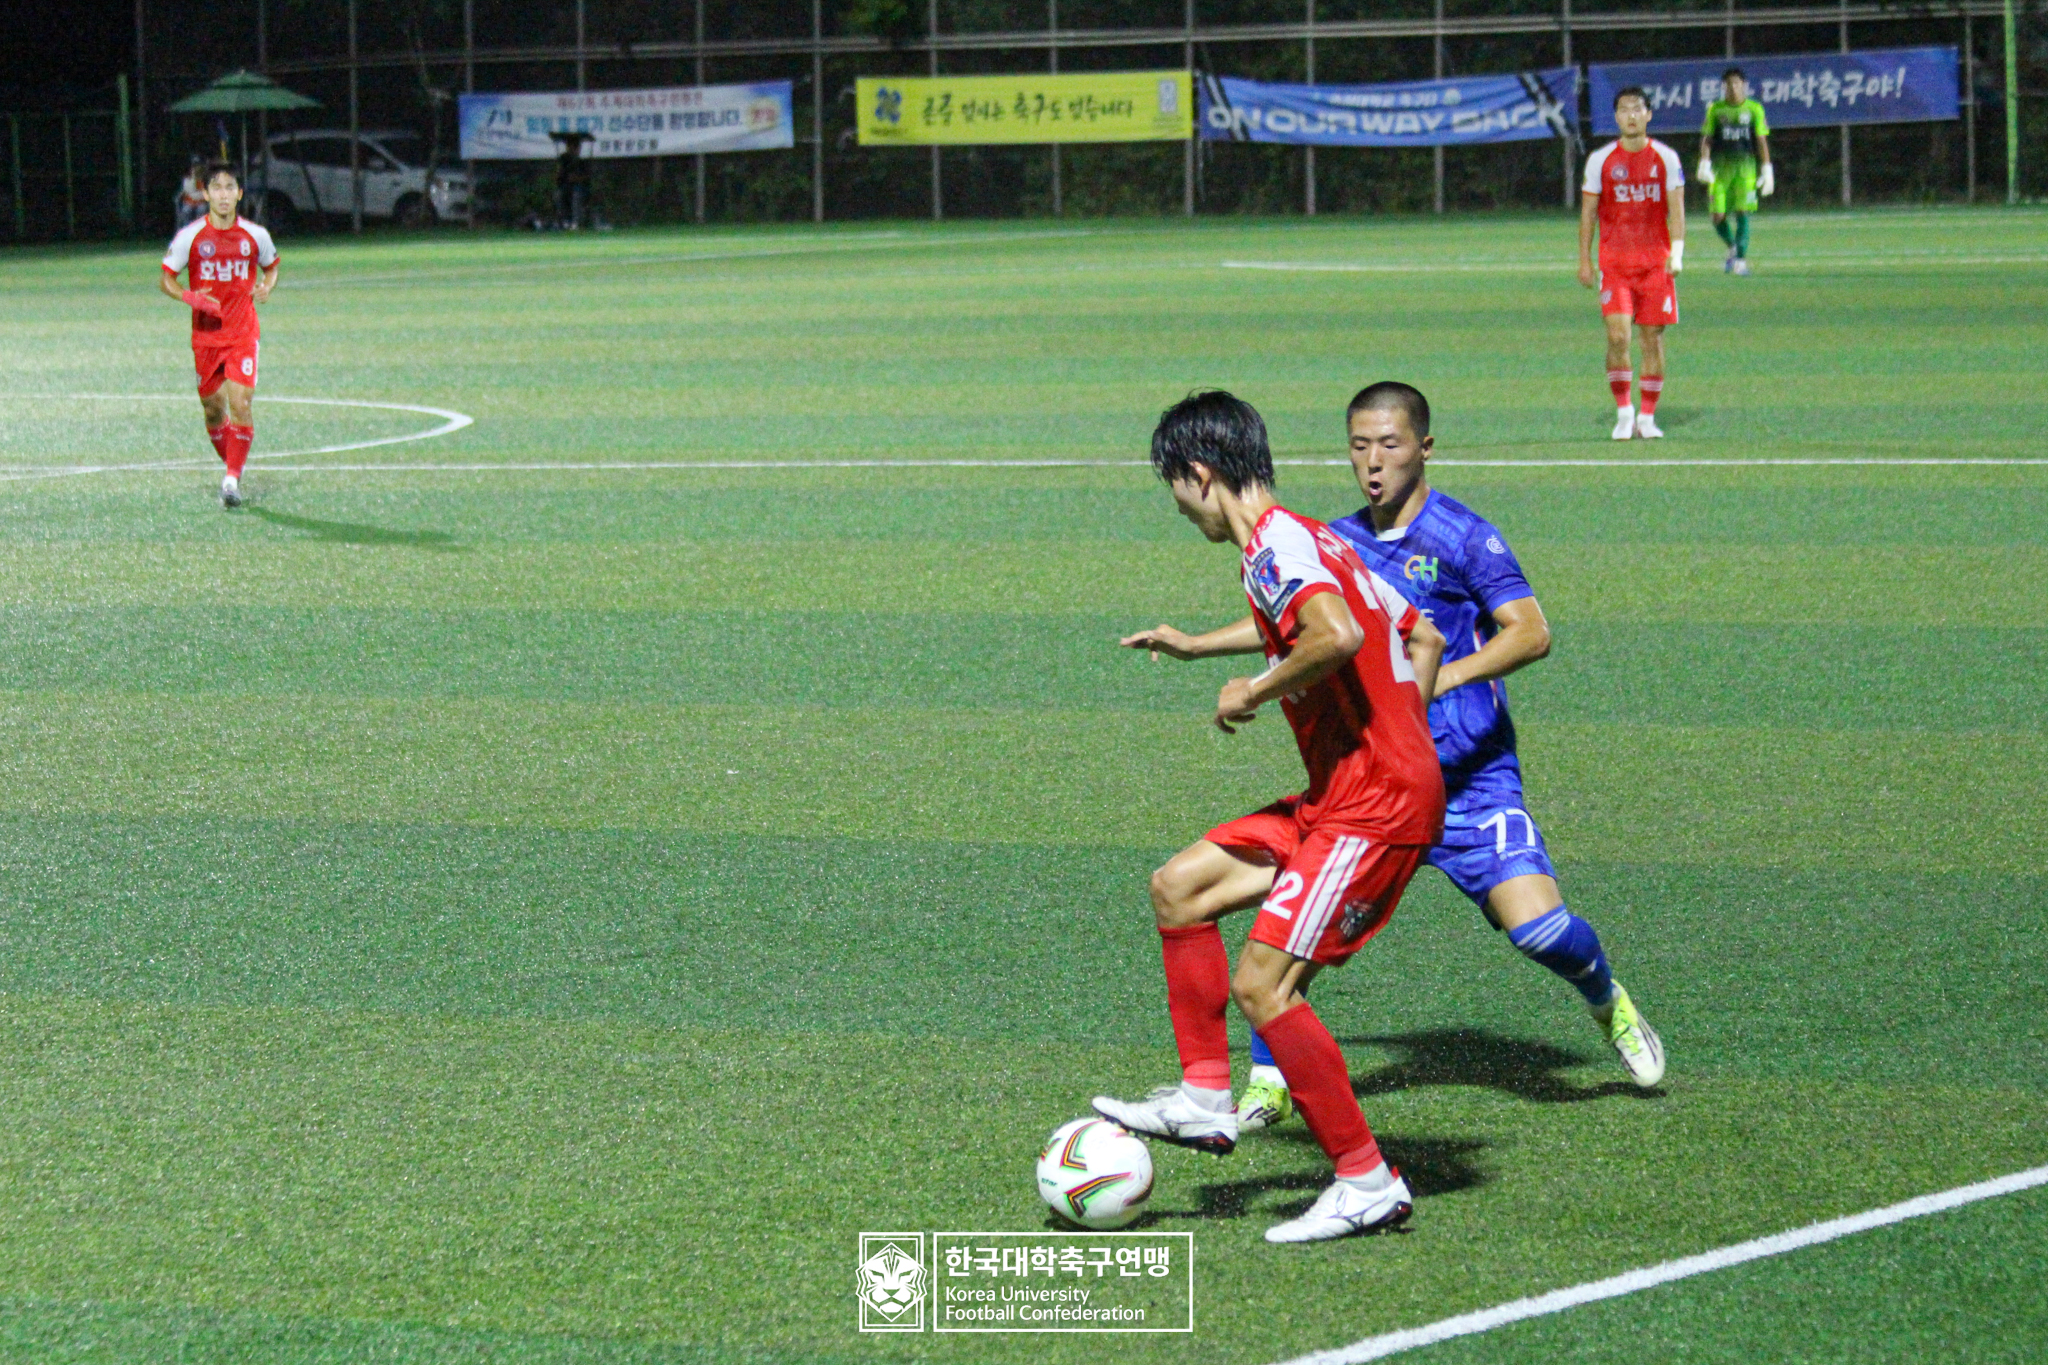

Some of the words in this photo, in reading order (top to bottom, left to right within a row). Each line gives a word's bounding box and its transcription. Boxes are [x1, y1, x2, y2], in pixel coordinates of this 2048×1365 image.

[1644, 79, 1692, 109] 다시
[1761, 66, 1906, 108] 대학축구야!
[1013, 92, 1062, 124] 축구도
[1208, 105, 1262, 133] ON
[1360, 111, 1444, 135] WAY
[1614, 183, 1661, 203] 호남대
[241, 240, 251, 256] 8
[200, 260, 250, 282] 호남대
[242, 358, 253, 375] 8
